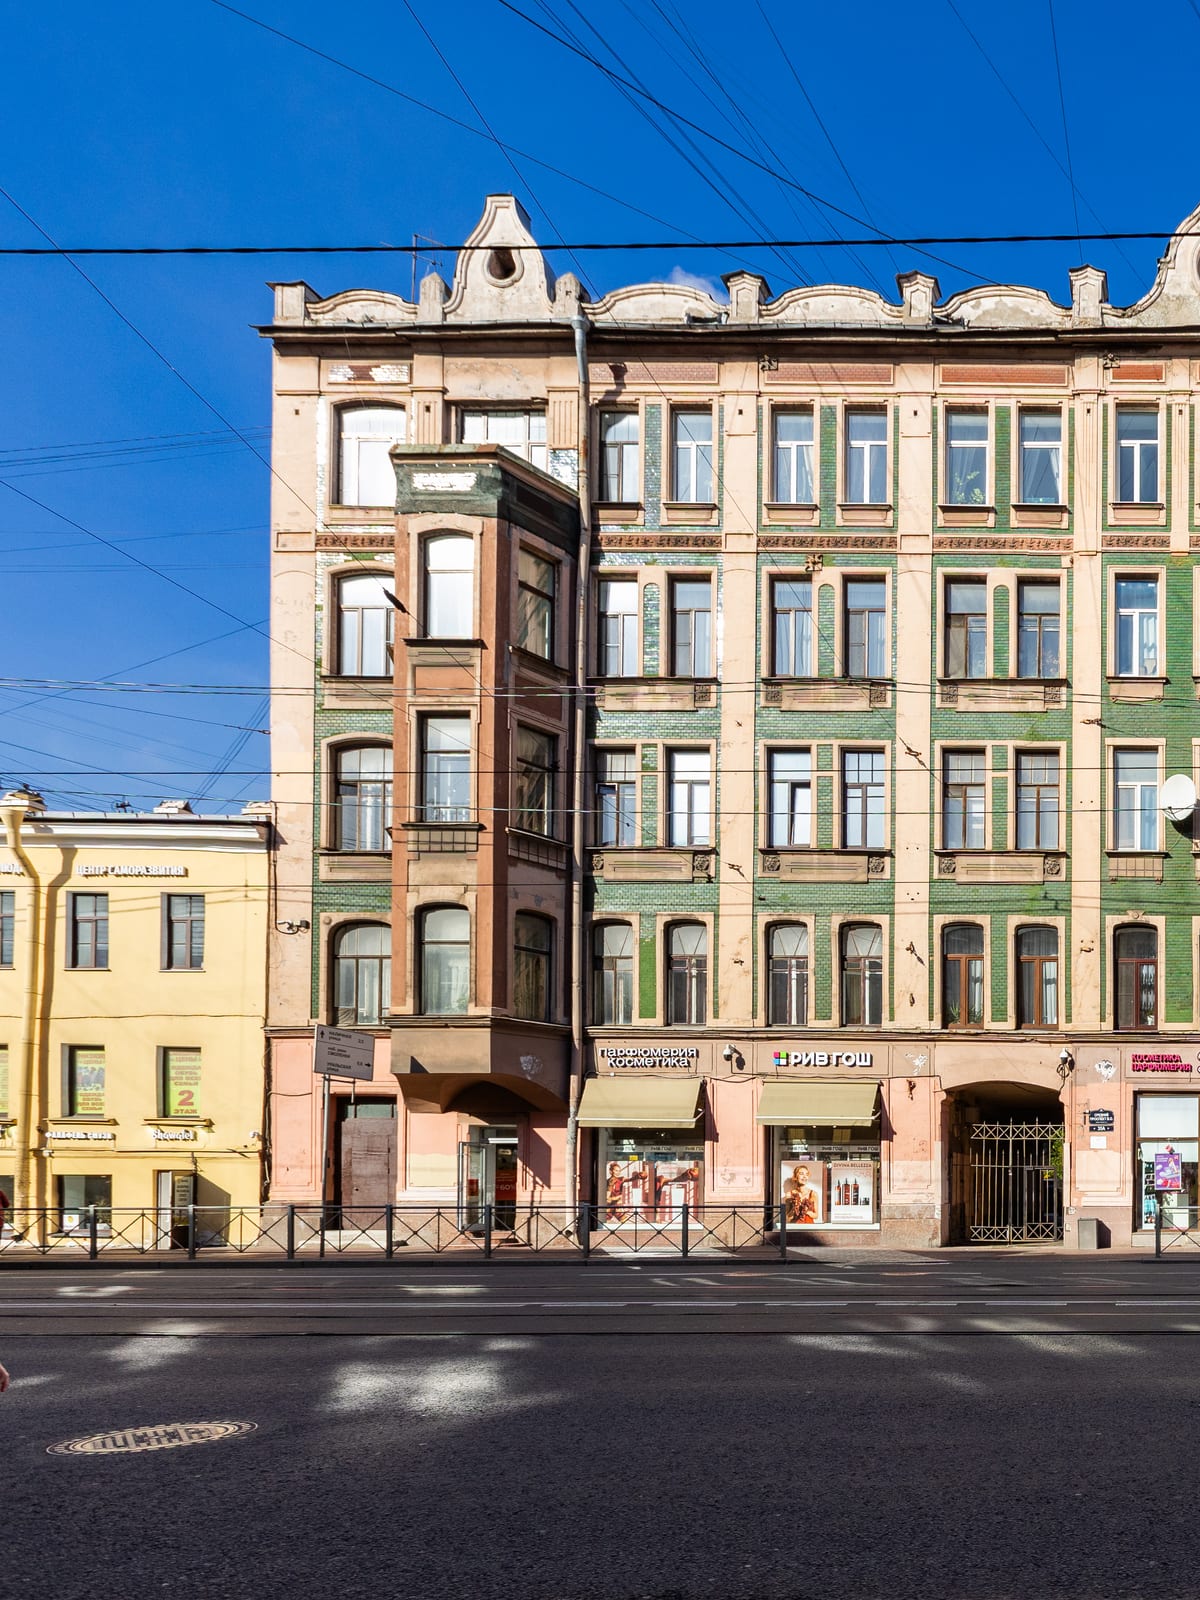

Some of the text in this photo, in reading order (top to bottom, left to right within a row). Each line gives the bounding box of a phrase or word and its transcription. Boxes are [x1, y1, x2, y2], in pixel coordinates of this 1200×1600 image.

[76, 864, 185, 876] ЦЕНТР САМОРАЗВИТИЯ
[598, 1047, 697, 1058] парфюмерия
[607, 1057, 689, 1067] косметика
[791, 1051, 872, 1066] РИВ ГОШ
[1131, 1054, 1182, 1063] КОСМЕТИКА
[1131, 1063, 1192, 1073] ПАРФЮМЕРИЯ
[178, 1089, 194, 1107] 2
